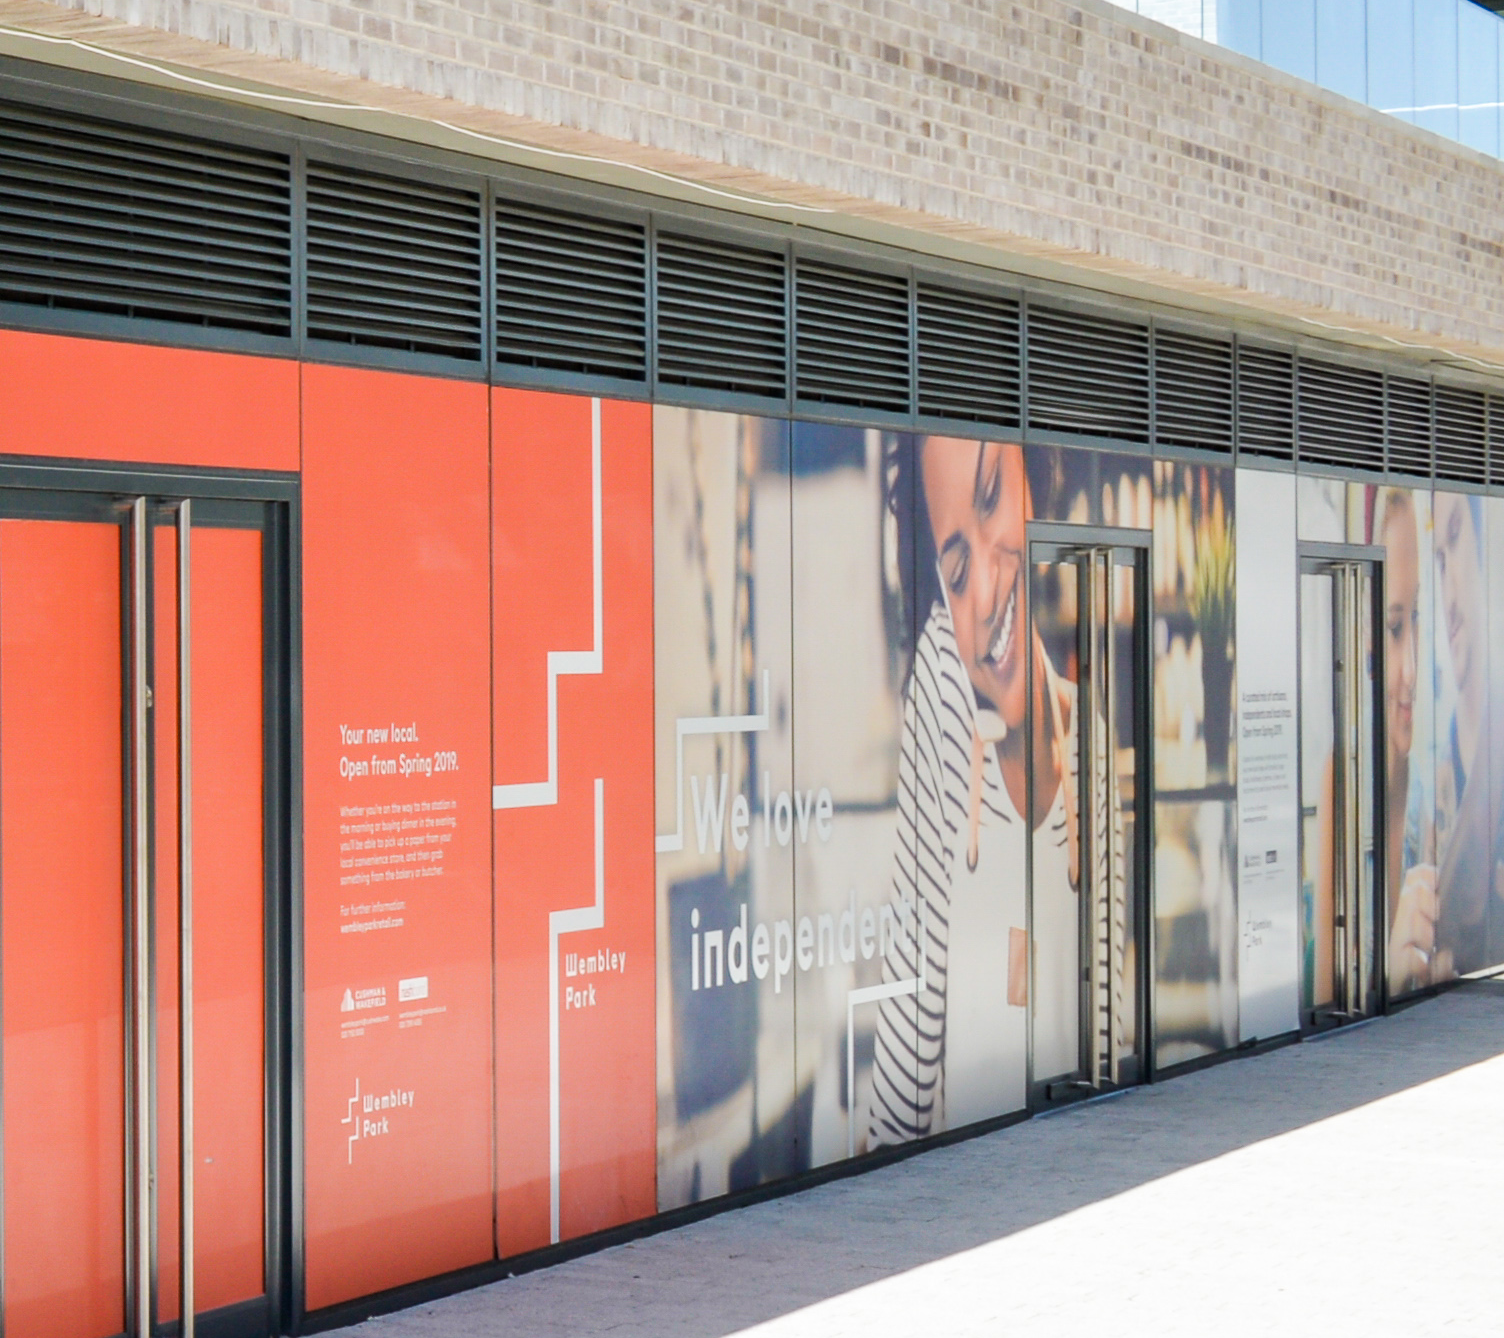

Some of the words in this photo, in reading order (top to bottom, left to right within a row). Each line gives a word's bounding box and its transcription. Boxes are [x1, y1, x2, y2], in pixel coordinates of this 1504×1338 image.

[340, 724, 364, 745] Your
[367, 728, 388, 743] new
[391, 722, 418, 742] local.
[340, 756, 368, 781] Open
[371, 755, 396, 775] from
[399, 753, 432, 778] Spring
[434, 751, 459, 771] 2019.
[691, 773, 749, 854] We
[764, 771, 833, 847] love
[691, 888, 912, 994] independent
[566, 948, 626, 977] Wembley
[566, 983, 595, 1010] Park
[363, 1089, 414, 1113] Wembley
[363, 1117, 388, 1137] Park
